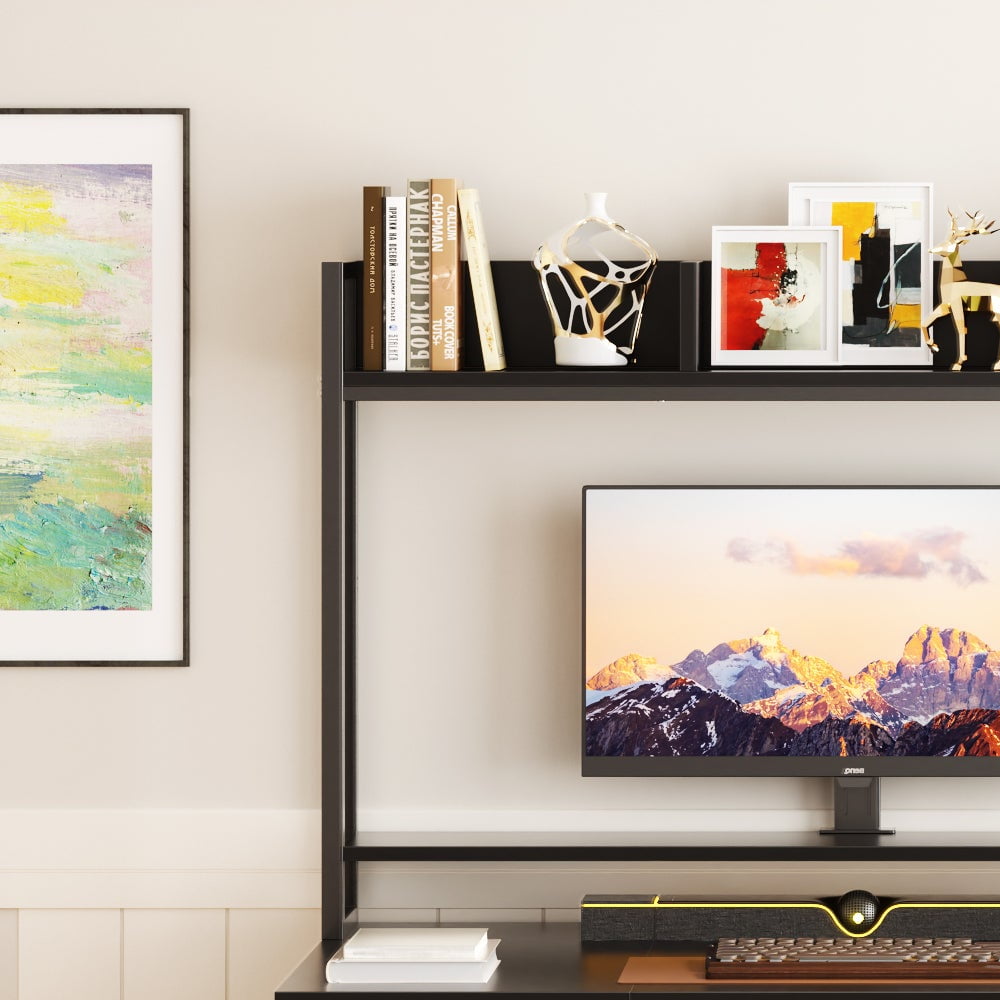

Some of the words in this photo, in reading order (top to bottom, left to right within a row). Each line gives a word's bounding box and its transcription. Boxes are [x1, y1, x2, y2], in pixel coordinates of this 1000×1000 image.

[431, 193, 443, 252] CHAPMAN
[446, 205, 456, 241] CALLUM
[409, 188, 430, 295] ПАСТЕРНАК
[410, 300, 430, 360] БОРИС
[432, 318, 442, 346] TUTS+
[444, 305, 455, 330] BOOK
[444, 331, 455, 359] COVER
